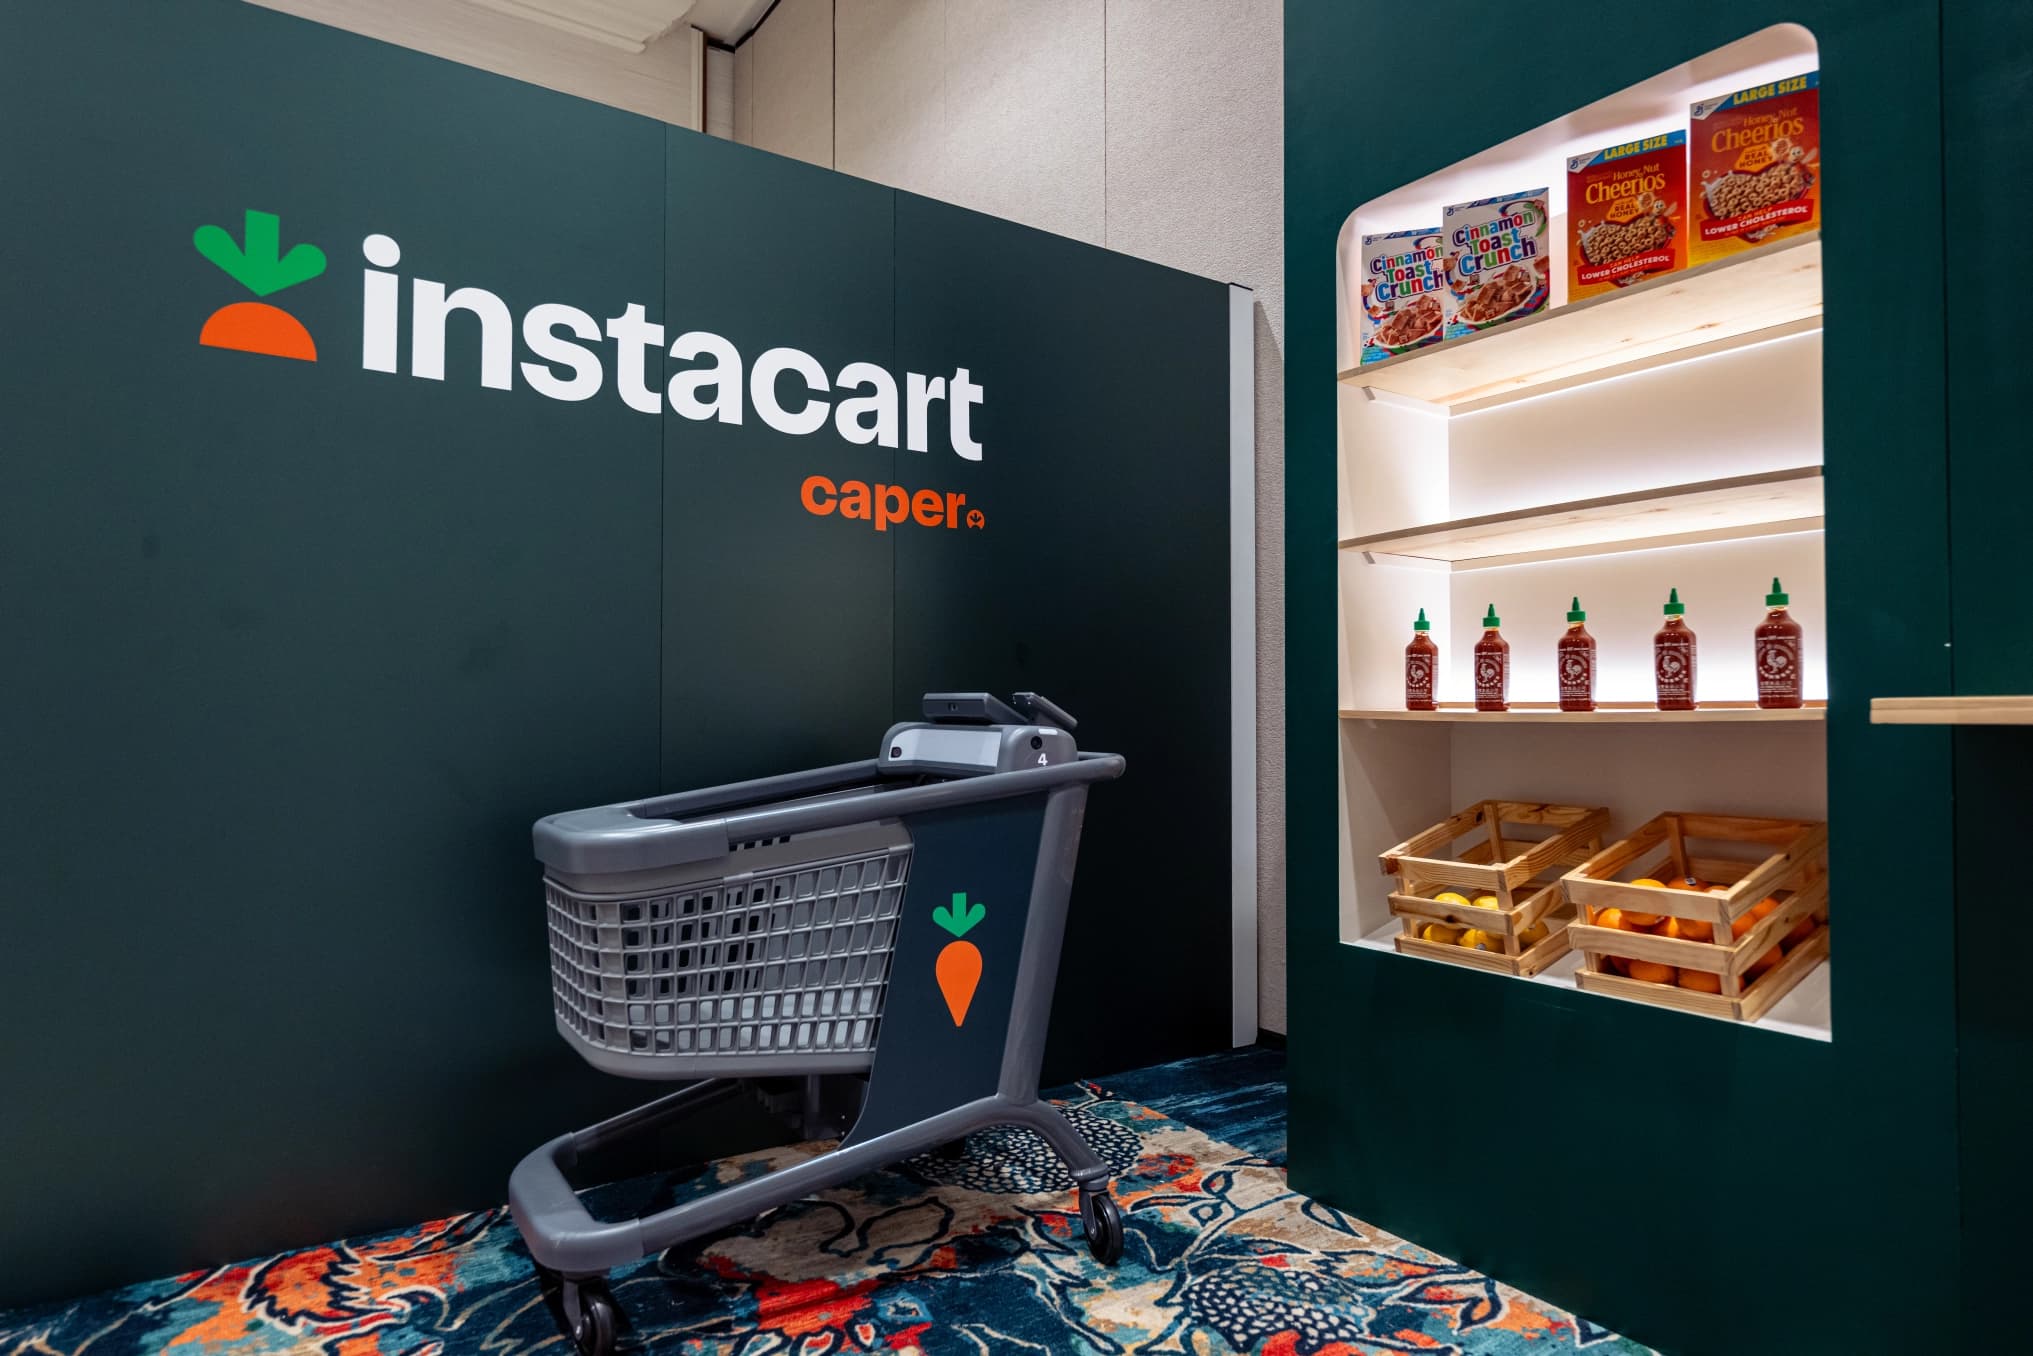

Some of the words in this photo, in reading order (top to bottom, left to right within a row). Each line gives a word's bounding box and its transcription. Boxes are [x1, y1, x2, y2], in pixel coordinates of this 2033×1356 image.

[1733, 84, 1775, 105] LARGE
[1778, 76, 1807, 94] SIZE
[1604, 143, 1640, 161] LARGE
[1643, 135, 1667, 151] SIZE
[1711, 117, 1804, 152] Cheerios
[1613, 167, 1644, 181] Honey
[1643, 162, 1660, 174] Nut
[1585, 173, 1666, 204] Cheerios
[1615, 202, 1636, 212] REAL
[1704, 223, 1739, 235] LOWER
[1739, 205, 1808, 228] CHOLESTEROL
[1455, 211, 1534, 244] Cinnamon
[1469, 227, 1521, 256] Toast
[1372, 245, 1443, 273] Cinnamon
[1460, 236, 1537, 275] Crunch
[1581, 269, 1611, 280] LOWER
[1611, 255, 1671, 274] CHOLESTEROL
[1377, 269, 1443, 301] Crunch
[1385, 259, 1433, 284] Toast
[362, 233, 985, 462] instacart
[800, 475, 966, 532] caper
[1037, 752, 1049, 766] 4
